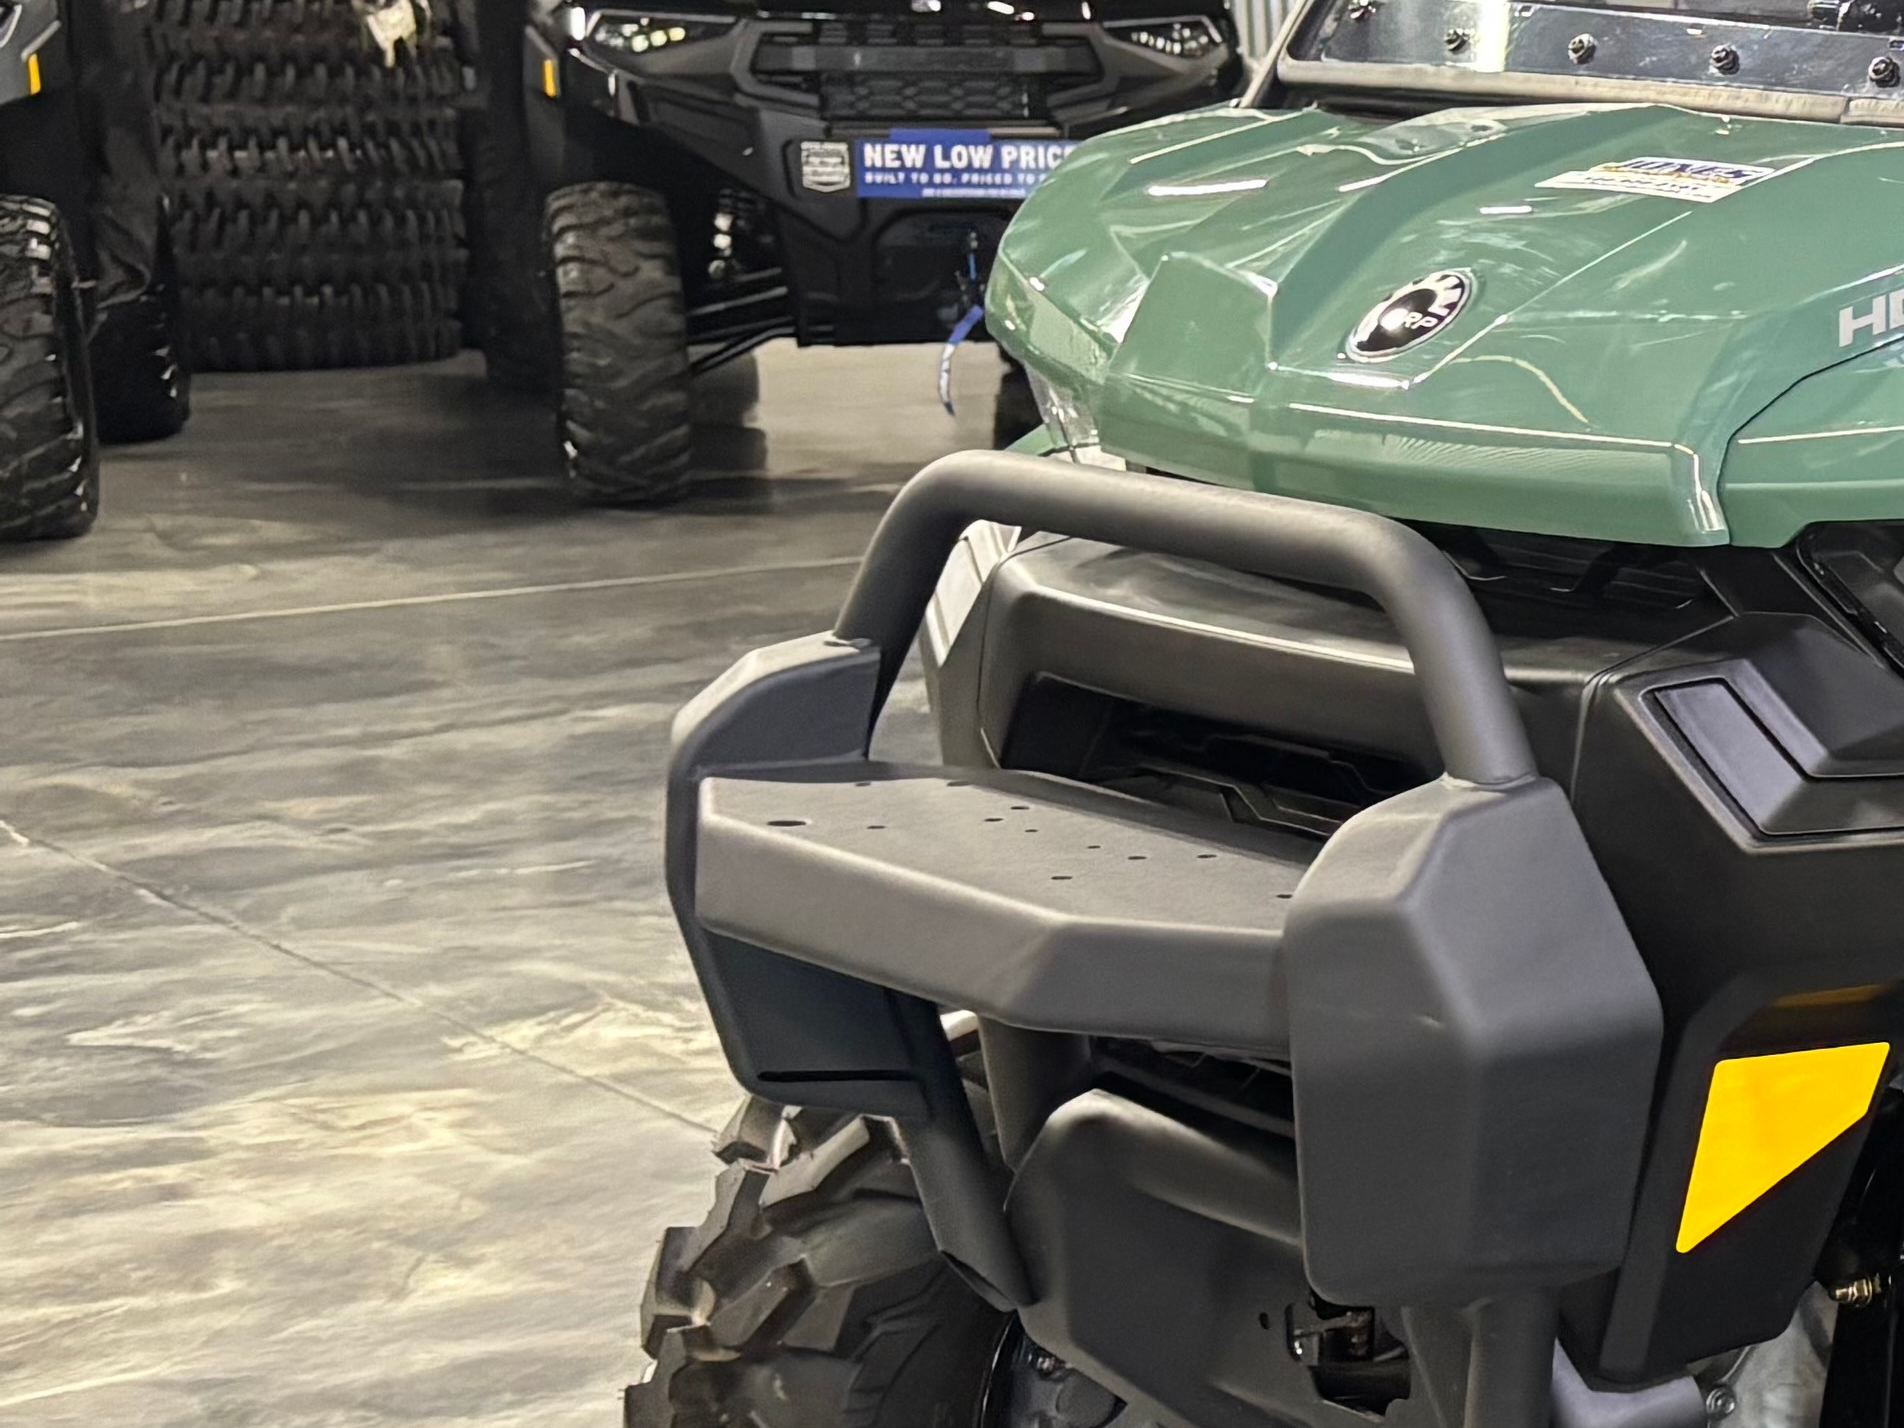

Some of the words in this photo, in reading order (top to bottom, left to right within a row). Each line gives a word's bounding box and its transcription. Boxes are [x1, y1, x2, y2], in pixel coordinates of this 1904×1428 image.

[863, 143, 926, 168] NEW
[933, 144, 993, 169] LOW
[1001, 145, 1076, 170] PRIC
